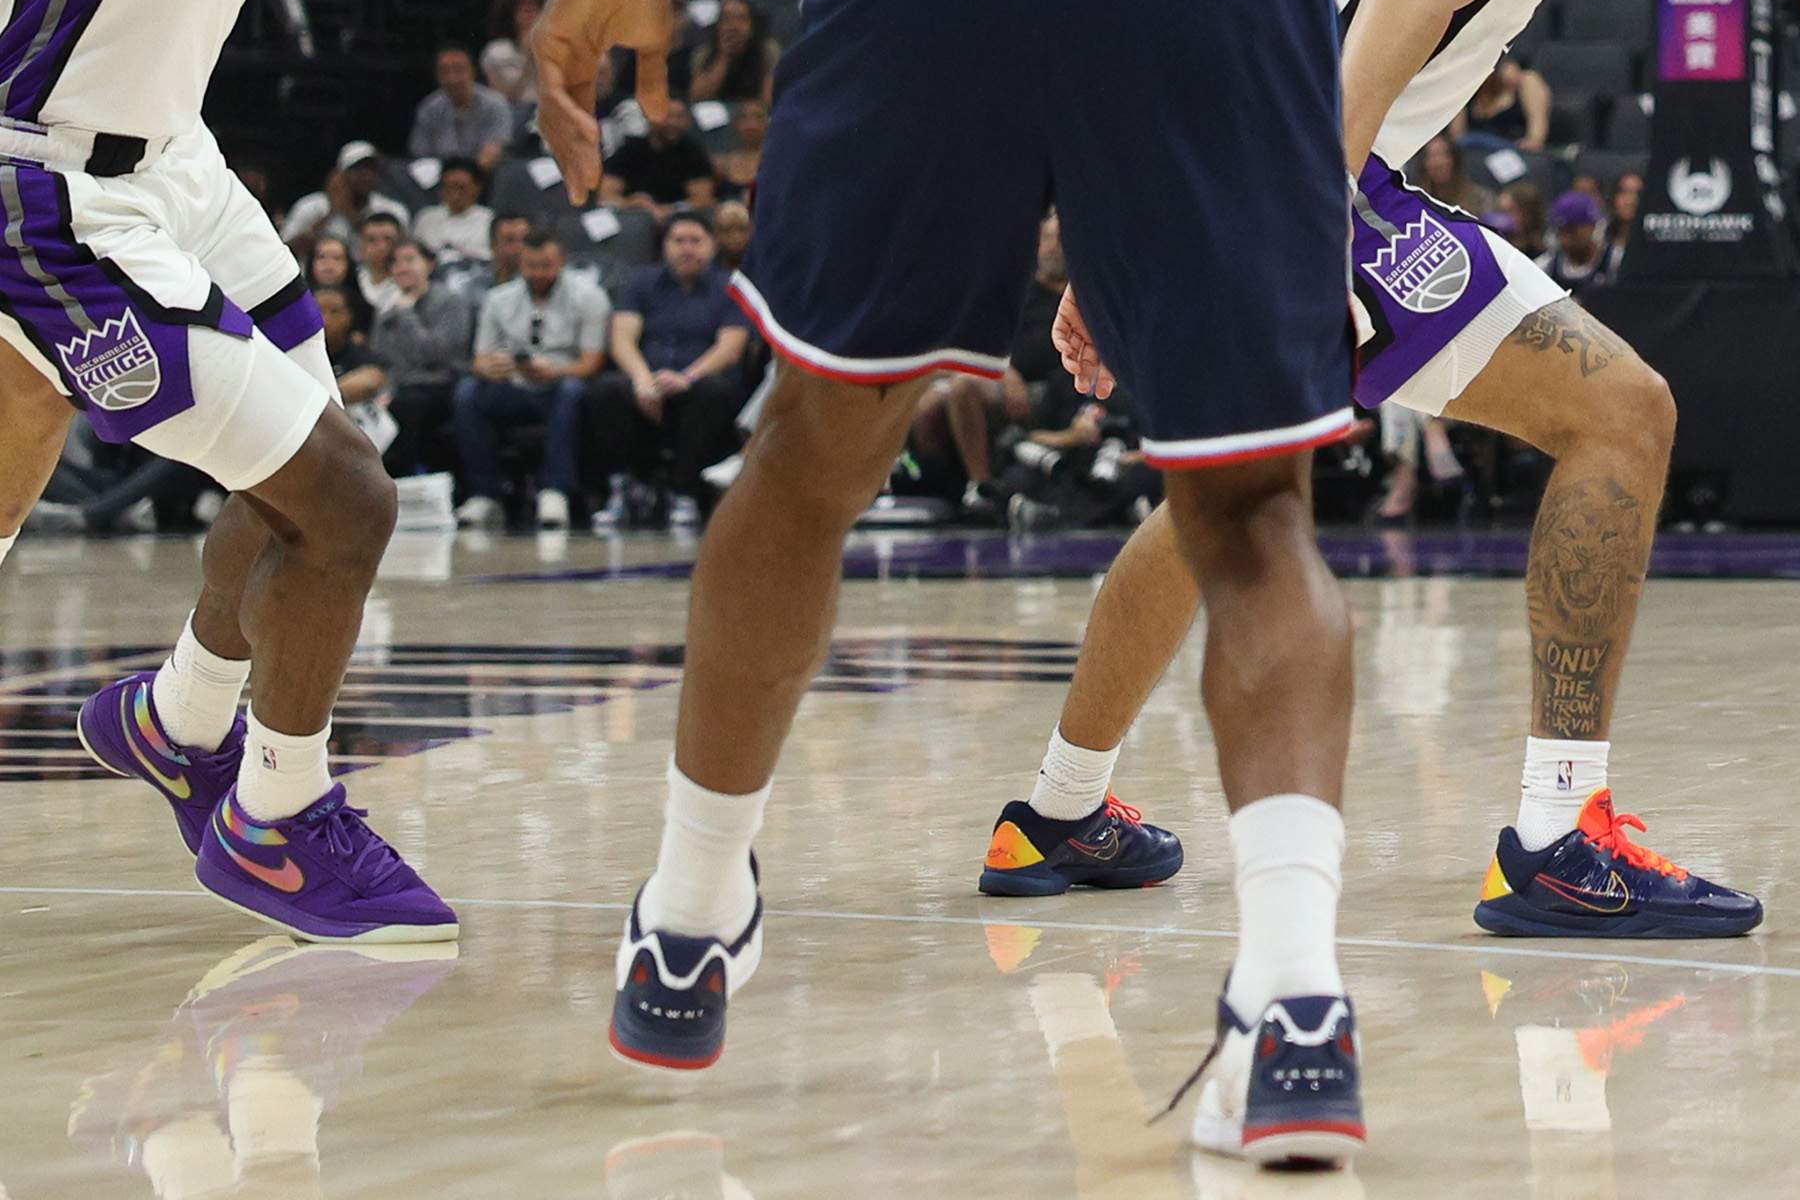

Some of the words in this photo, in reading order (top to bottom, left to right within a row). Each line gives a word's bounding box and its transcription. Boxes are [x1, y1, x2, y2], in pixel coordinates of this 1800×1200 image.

[1384, 229, 1443, 285] SACRAMENTO
[1391, 235, 1460, 302] KINGS
[74, 335, 141, 373] SACRAMENTO
[79, 344, 155, 390] KINGS
[1547, 640, 1609, 678] ONLY
[1550, 672, 1592, 699] THE
